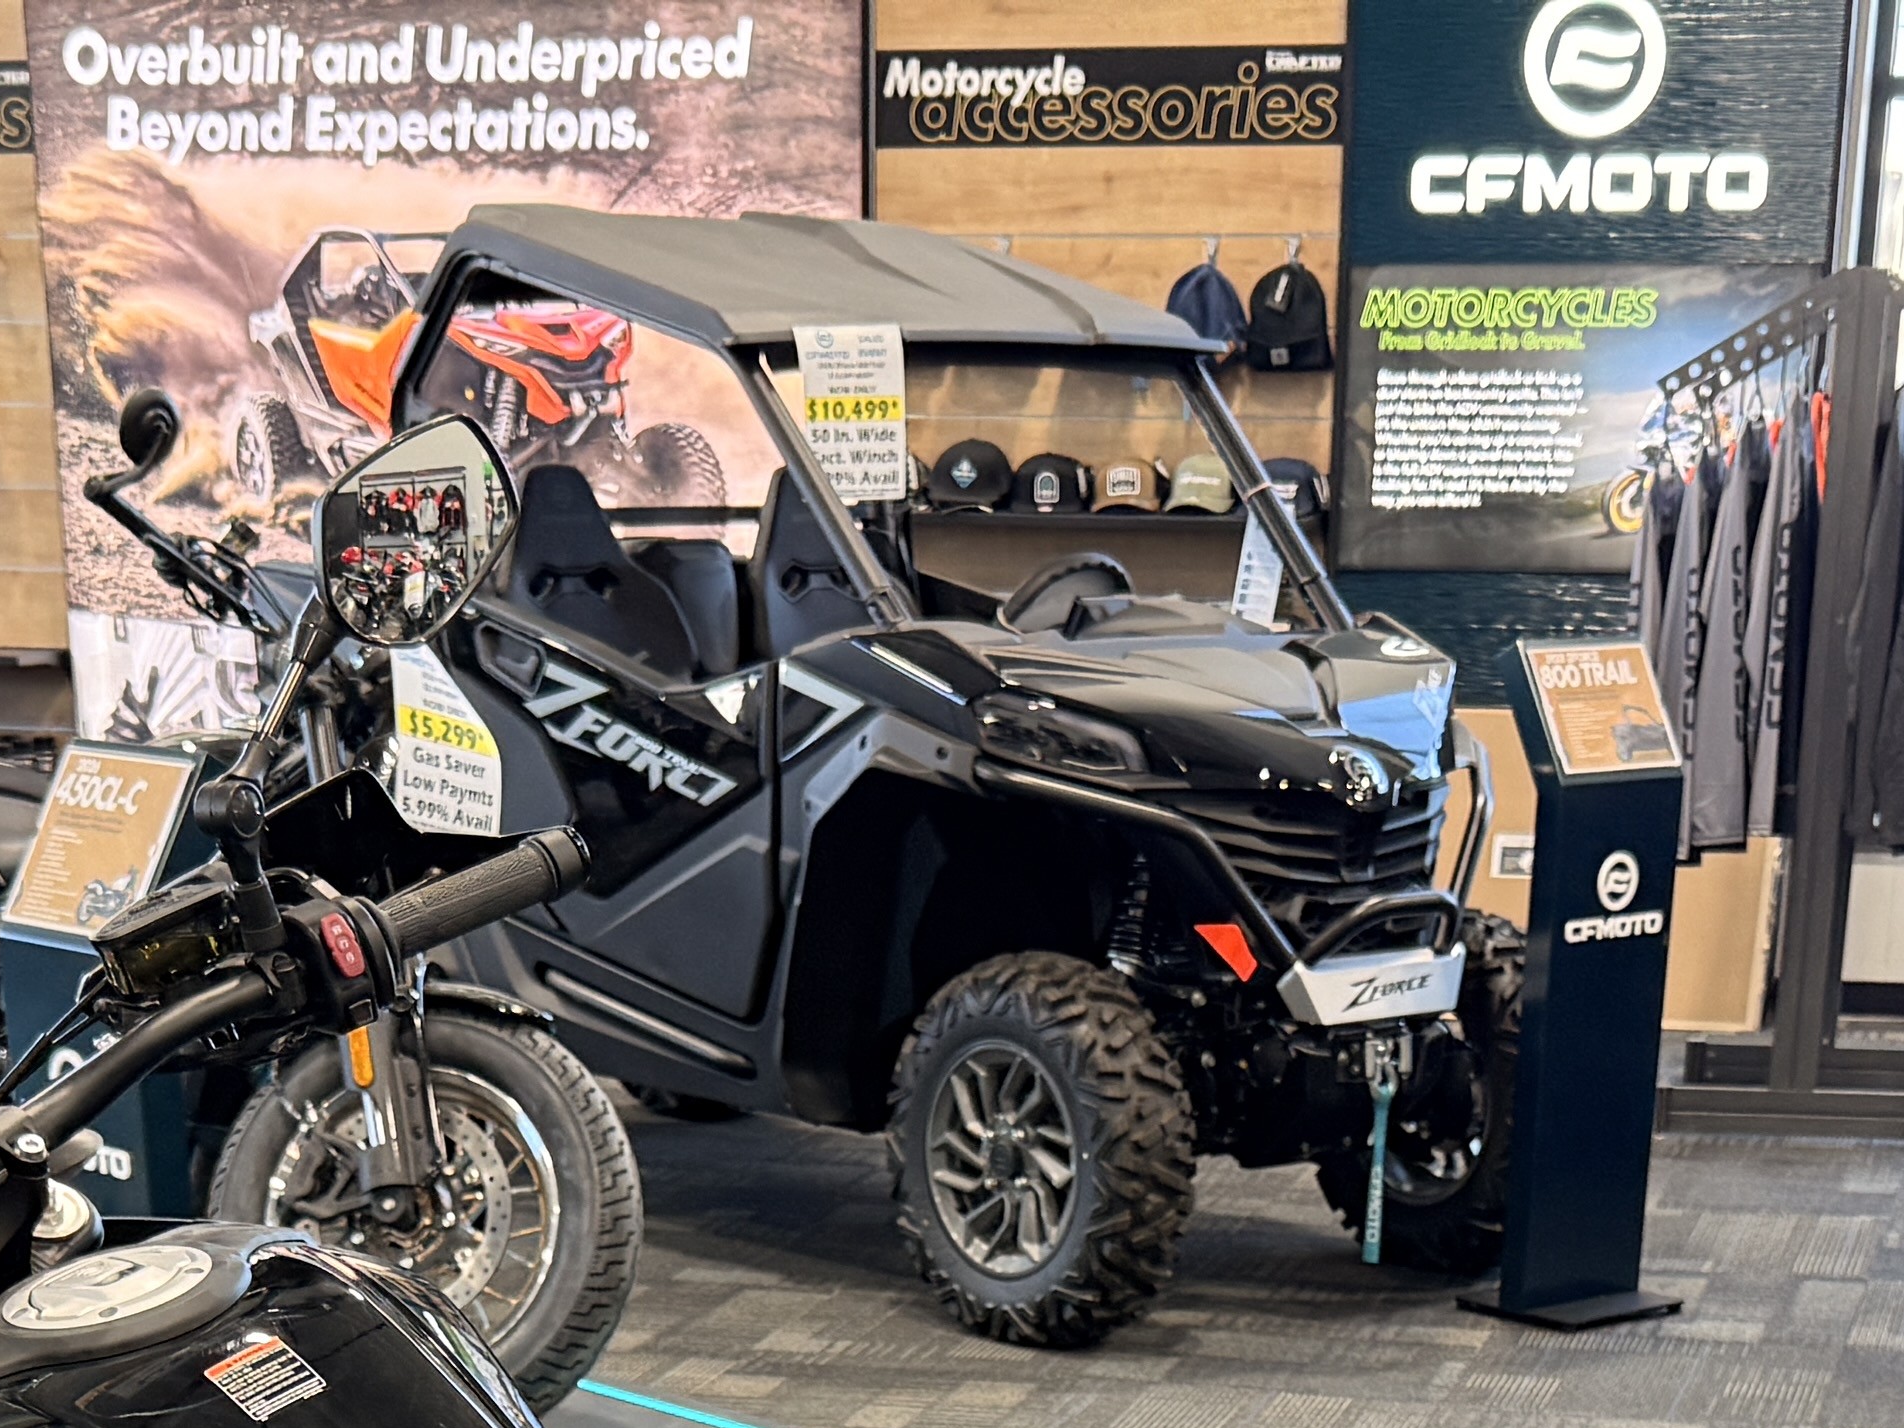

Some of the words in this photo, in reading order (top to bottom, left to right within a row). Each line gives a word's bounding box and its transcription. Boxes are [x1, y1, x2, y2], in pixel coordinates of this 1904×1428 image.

[63, 24, 303, 87] Overbuilt
[311, 23, 415, 85] and
[425, 16, 754, 97] Underpriced
[883, 55, 1086, 107] Motorcycle
[909, 60, 1339, 142] accessories
[106, 93, 295, 166] Beyond
[303, 93, 650, 166] Expectations.
[1410, 153, 1770, 214] CFMOTO
[1359, 287, 1660, 329] MOTORCYCLES
[1539, 664, 1581, 688] 800
[1580, 659, 1638, 686] TRAIL
[403, 769, 436, 794] Low
[412, 747, 440, 769] Gas
[444, 754, 486, 779] Saver
[54, 772, 150, 816] 450CL-C
[402, 796, 449, 823] 5.99%
[452, 808, 494, 833] Avail
[1564, 909, 1665, 944] CFMOTO
[1342, 973, 1434, 1011] ZFORCE
